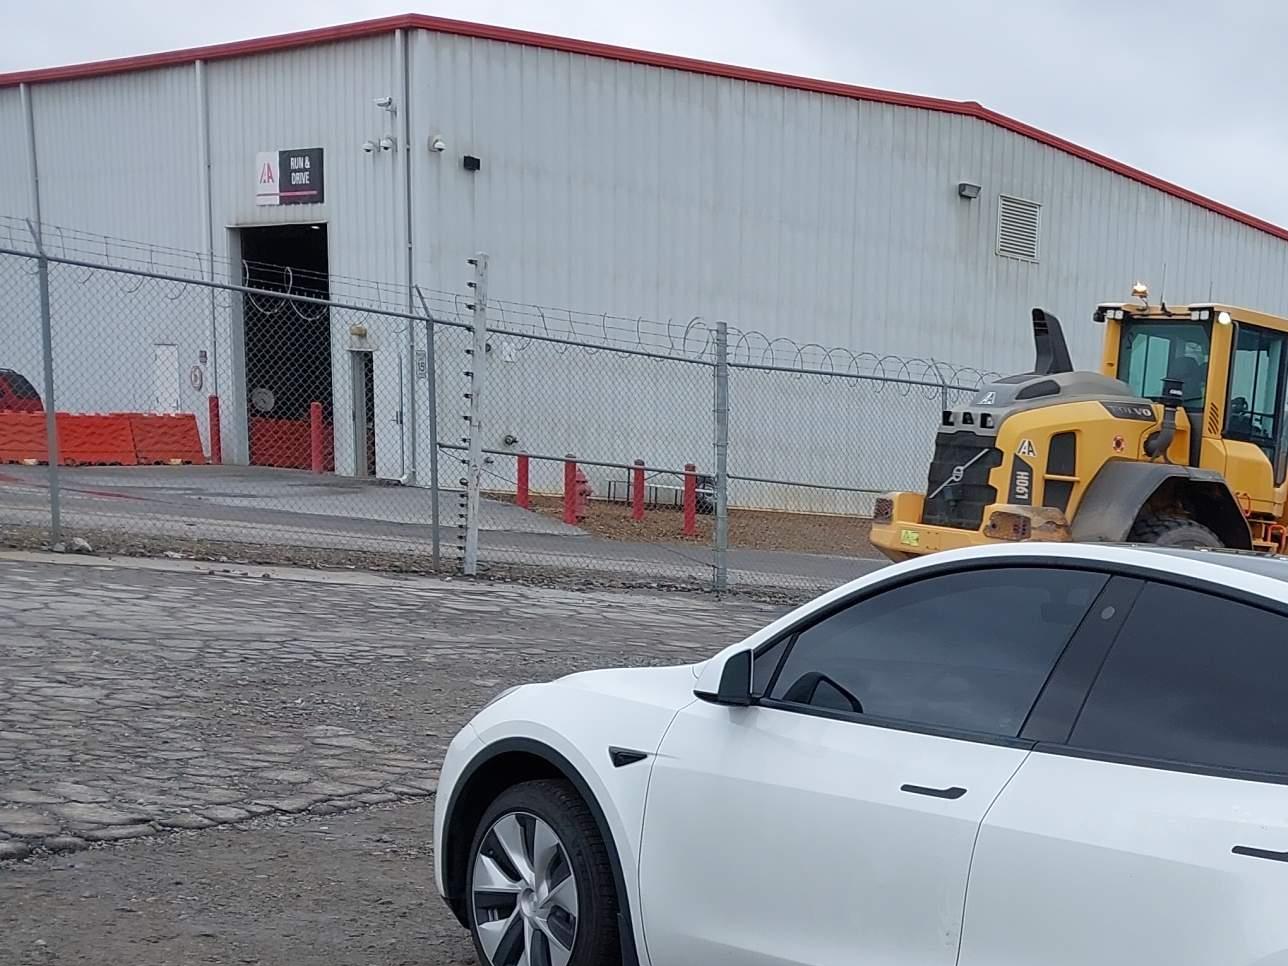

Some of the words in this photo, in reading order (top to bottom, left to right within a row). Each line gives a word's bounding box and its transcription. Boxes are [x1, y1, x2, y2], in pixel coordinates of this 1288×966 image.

[290, 156, 304, 170] RUN
[304, 156, 311, 169] &
[291, 172, 310, 185] DRIVE
[1015, 471, 1030, 500] L90H
